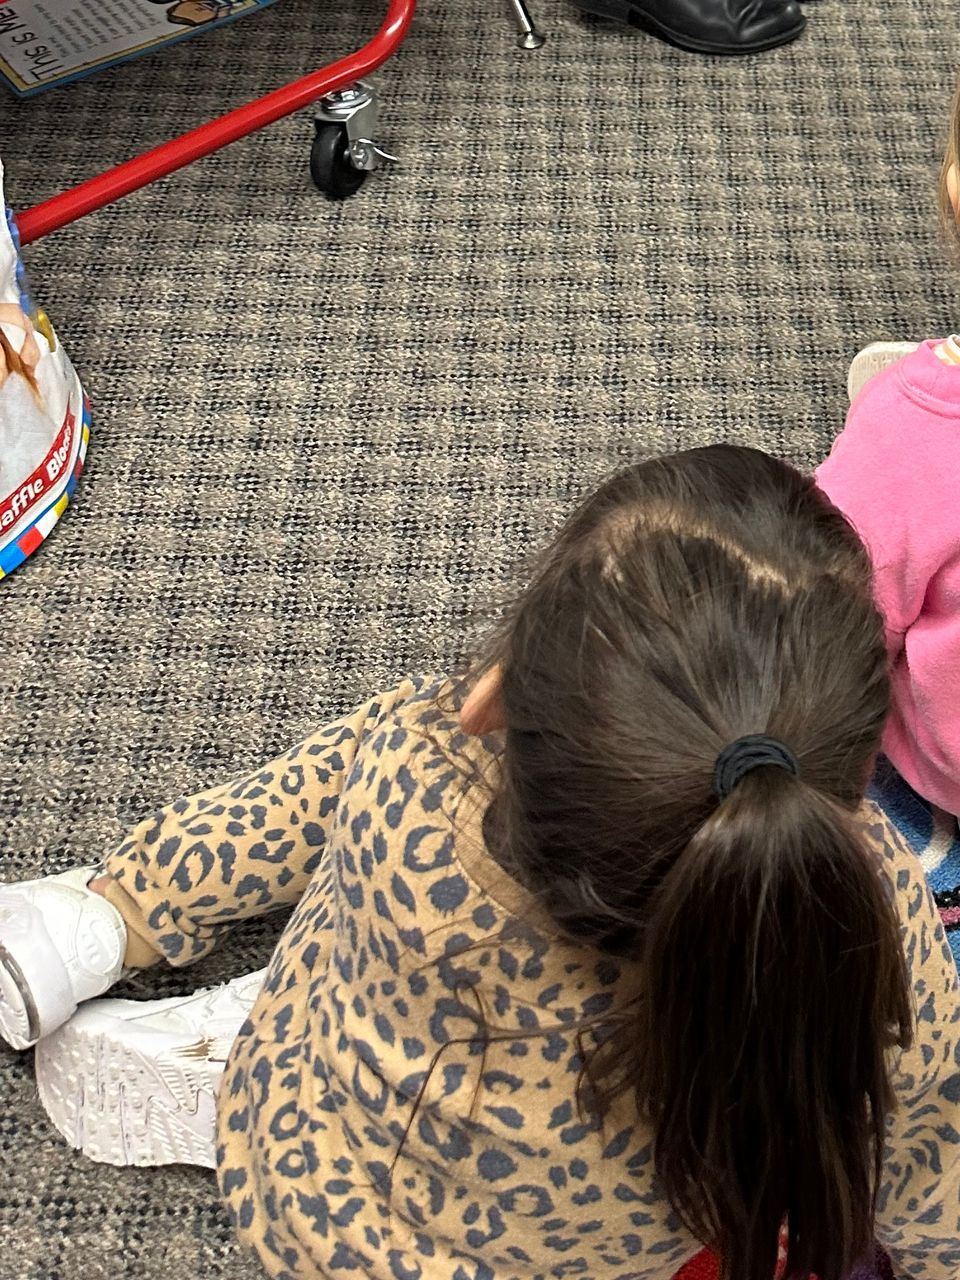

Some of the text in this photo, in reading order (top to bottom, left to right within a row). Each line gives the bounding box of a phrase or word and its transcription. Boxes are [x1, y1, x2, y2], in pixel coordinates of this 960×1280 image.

[12, 31, 36, 50] is
[24, 47, 65, 80] This
[0, 477, 44, 532] affle
